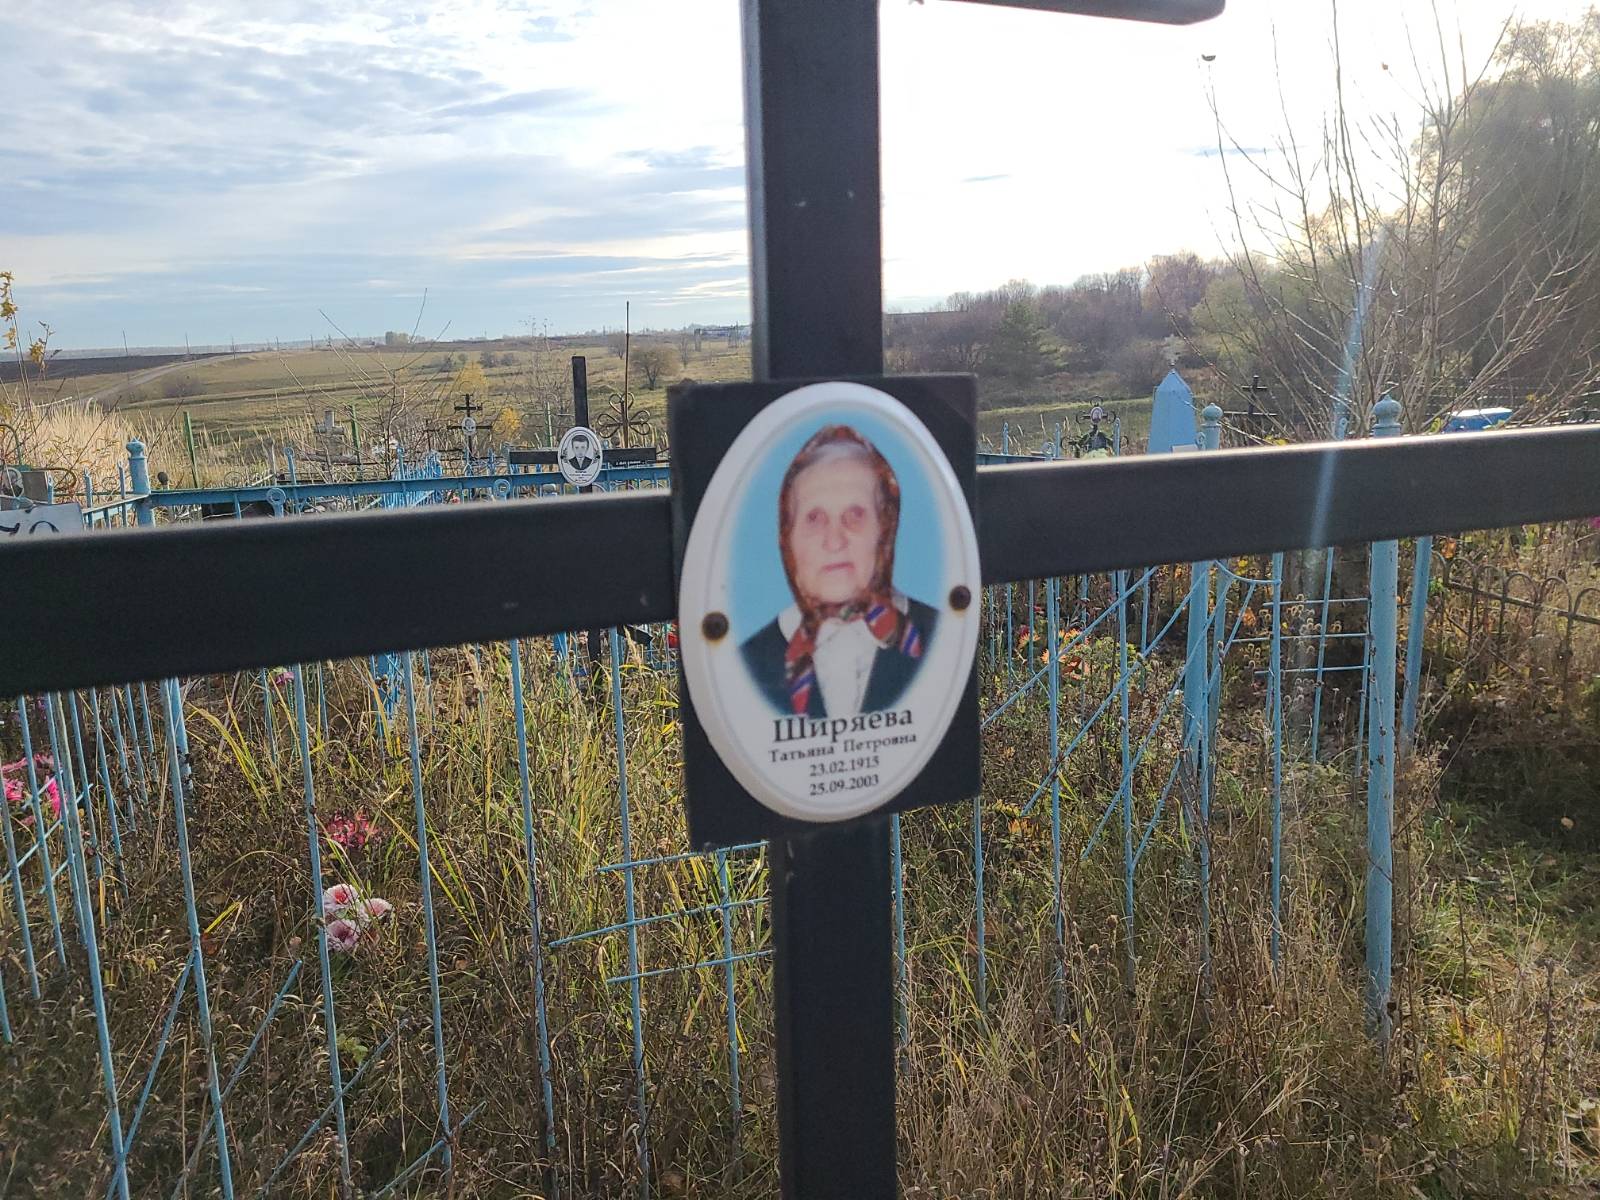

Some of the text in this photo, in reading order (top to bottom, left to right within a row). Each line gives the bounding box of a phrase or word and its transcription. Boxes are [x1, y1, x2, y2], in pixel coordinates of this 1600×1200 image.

[774, 709, 912, 743] Ширяева
[769, 733, 917, 763] Татьяна Петровна
[809, 755, 880, 777] 23.02.1915
[809, 774, 880, 796] 25.09.2003
